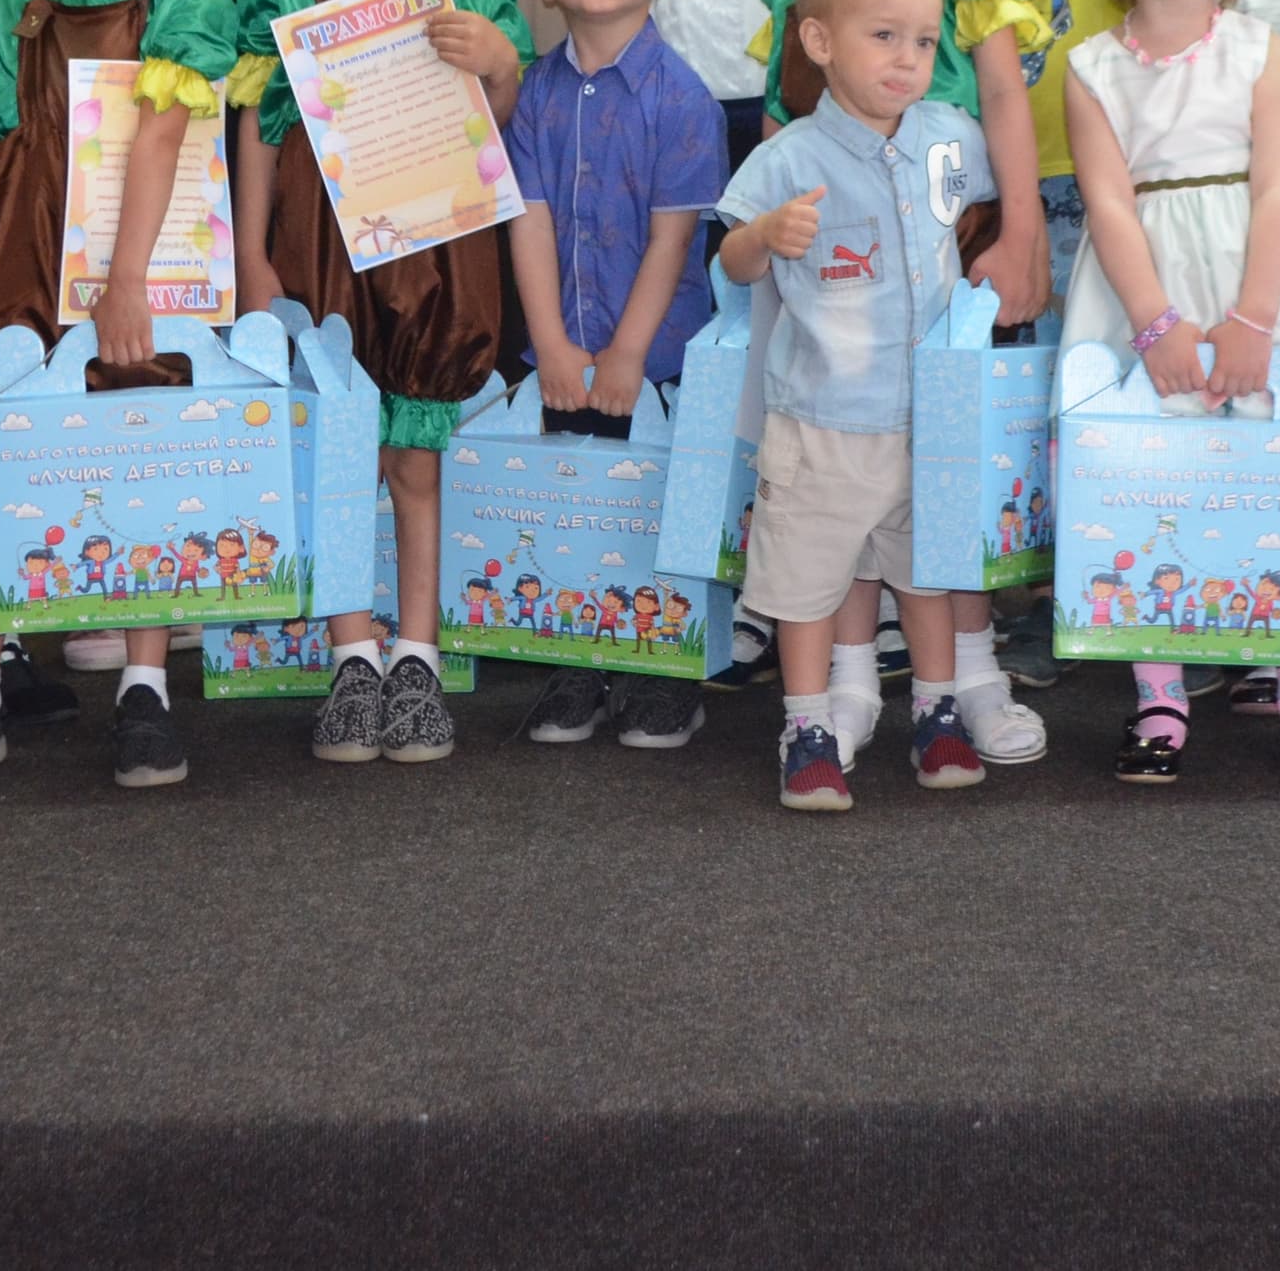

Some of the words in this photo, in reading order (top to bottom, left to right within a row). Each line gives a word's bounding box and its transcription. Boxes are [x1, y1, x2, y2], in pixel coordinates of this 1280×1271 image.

[926, 140, 962, 227] C
[0, 436, 219, 462] БЛАГОТВОРИТЕЛЬНЫЙ
[224, 436, 278, 449] ФОНД
[28, 466, 115, 486] «ЛУЧИК
[125, 458, 253, 483] ДЕТСТВА»
[451, 480, 642, 509] БЛАГОТВОРИТЕЛЬНЫЙ
[1102, 490, 1193, 509] «ЛУЧИК
[473, 504, 547, 525] «ЛУЧИК
